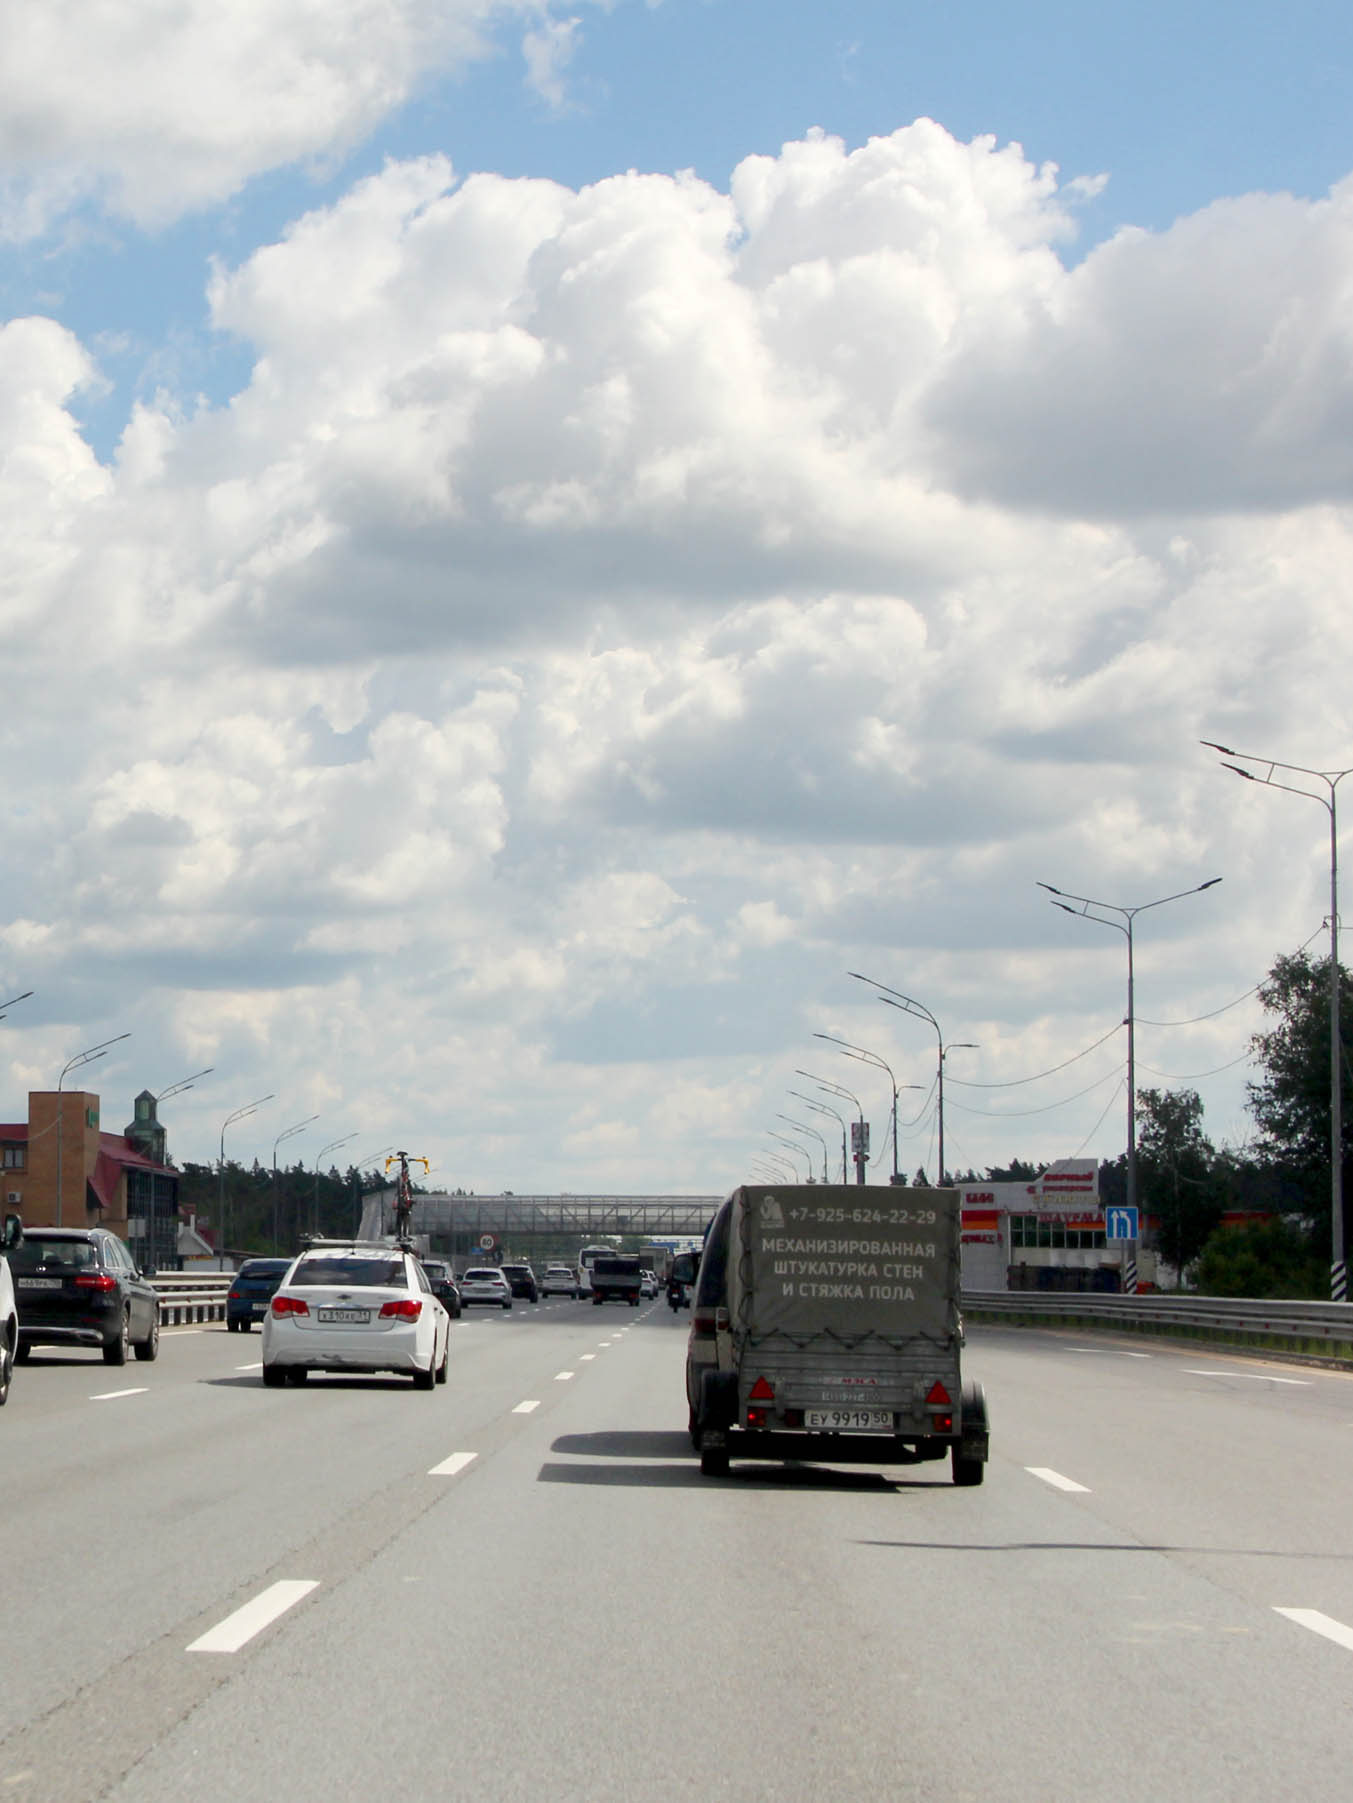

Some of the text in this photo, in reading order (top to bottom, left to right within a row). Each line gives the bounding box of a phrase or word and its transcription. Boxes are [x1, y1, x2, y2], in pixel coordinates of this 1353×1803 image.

[790, 1207, 936, 1224] +7-925-624-22-29
[762, 1238, 936, 1258] МЕХАНИЗИРОВАННАЯ
[774, 1261, 923, 1279] ШТУКАТУРКА СТЕН
[782, 1283, 915, 1300] И СТЯЖКА ПОЛА
